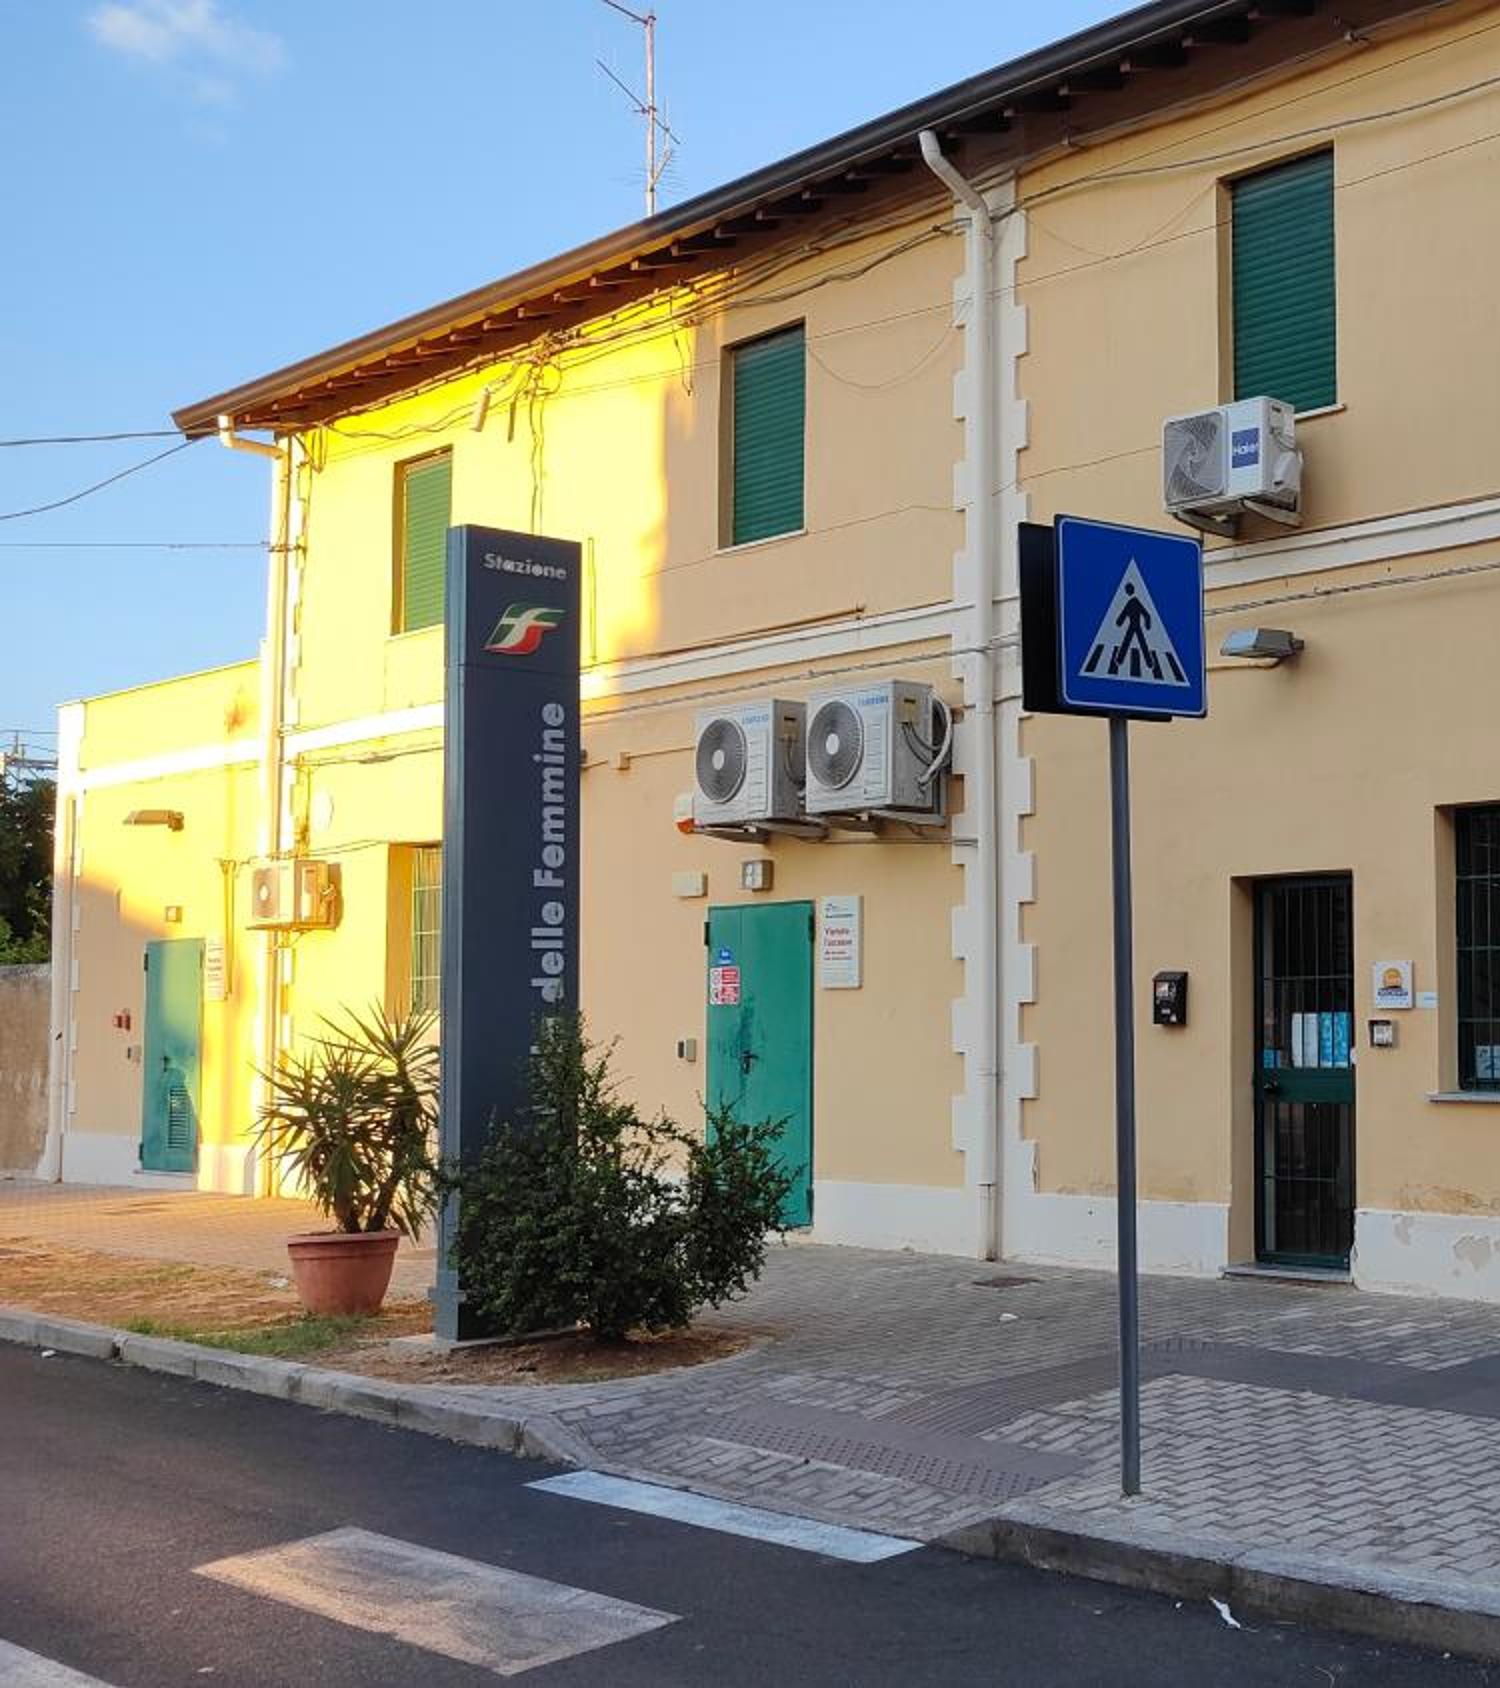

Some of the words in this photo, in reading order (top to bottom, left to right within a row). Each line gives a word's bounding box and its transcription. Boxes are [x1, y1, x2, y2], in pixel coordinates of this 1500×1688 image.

[483, 552, 567, 579] Stazione
[533, 702, 565, 887] Femmine
[531, 901, 565, 1003] delle
